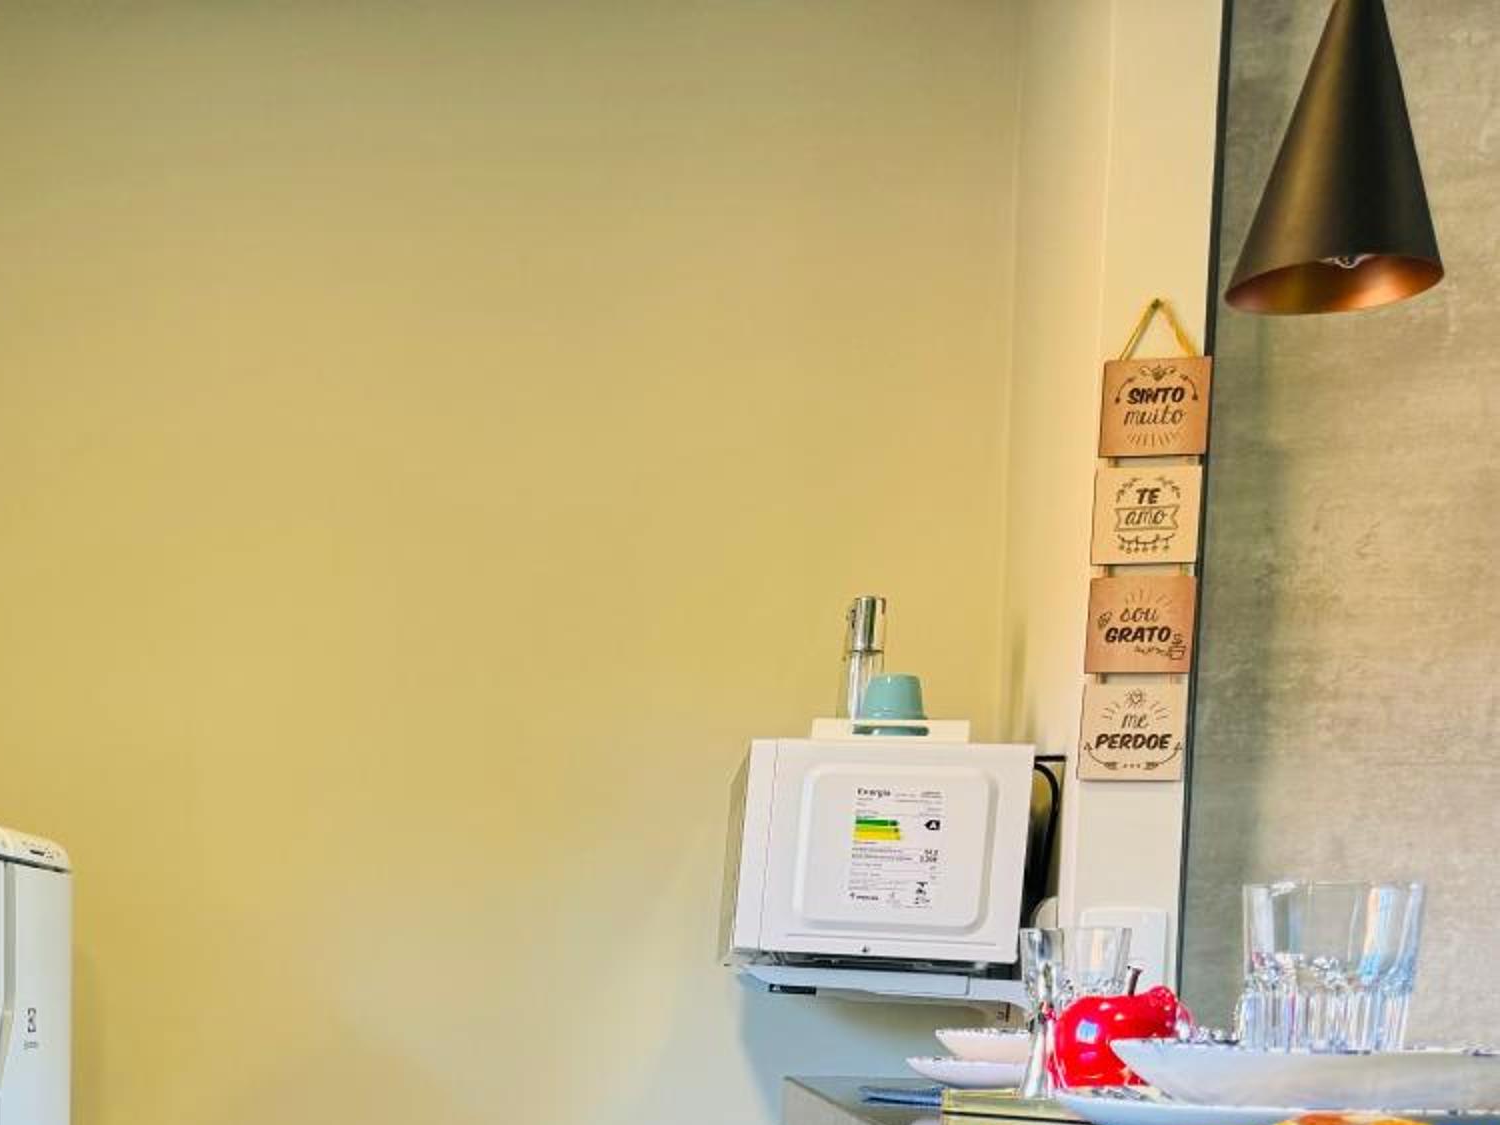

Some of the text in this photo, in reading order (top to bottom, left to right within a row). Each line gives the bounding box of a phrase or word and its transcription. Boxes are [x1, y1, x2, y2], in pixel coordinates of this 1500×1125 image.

[1126, 387, 1185, 405] SINTO
[1124, 404, 1186, 426] muito
[1136, 487, 1161, 504] TE
[1125, 510, 1168, 525] amo
[1105, 625, 1171, 643] GRATO
[1121, 713, 1149, 729] me
[1095, 733, 1172, 750] PERDOE
